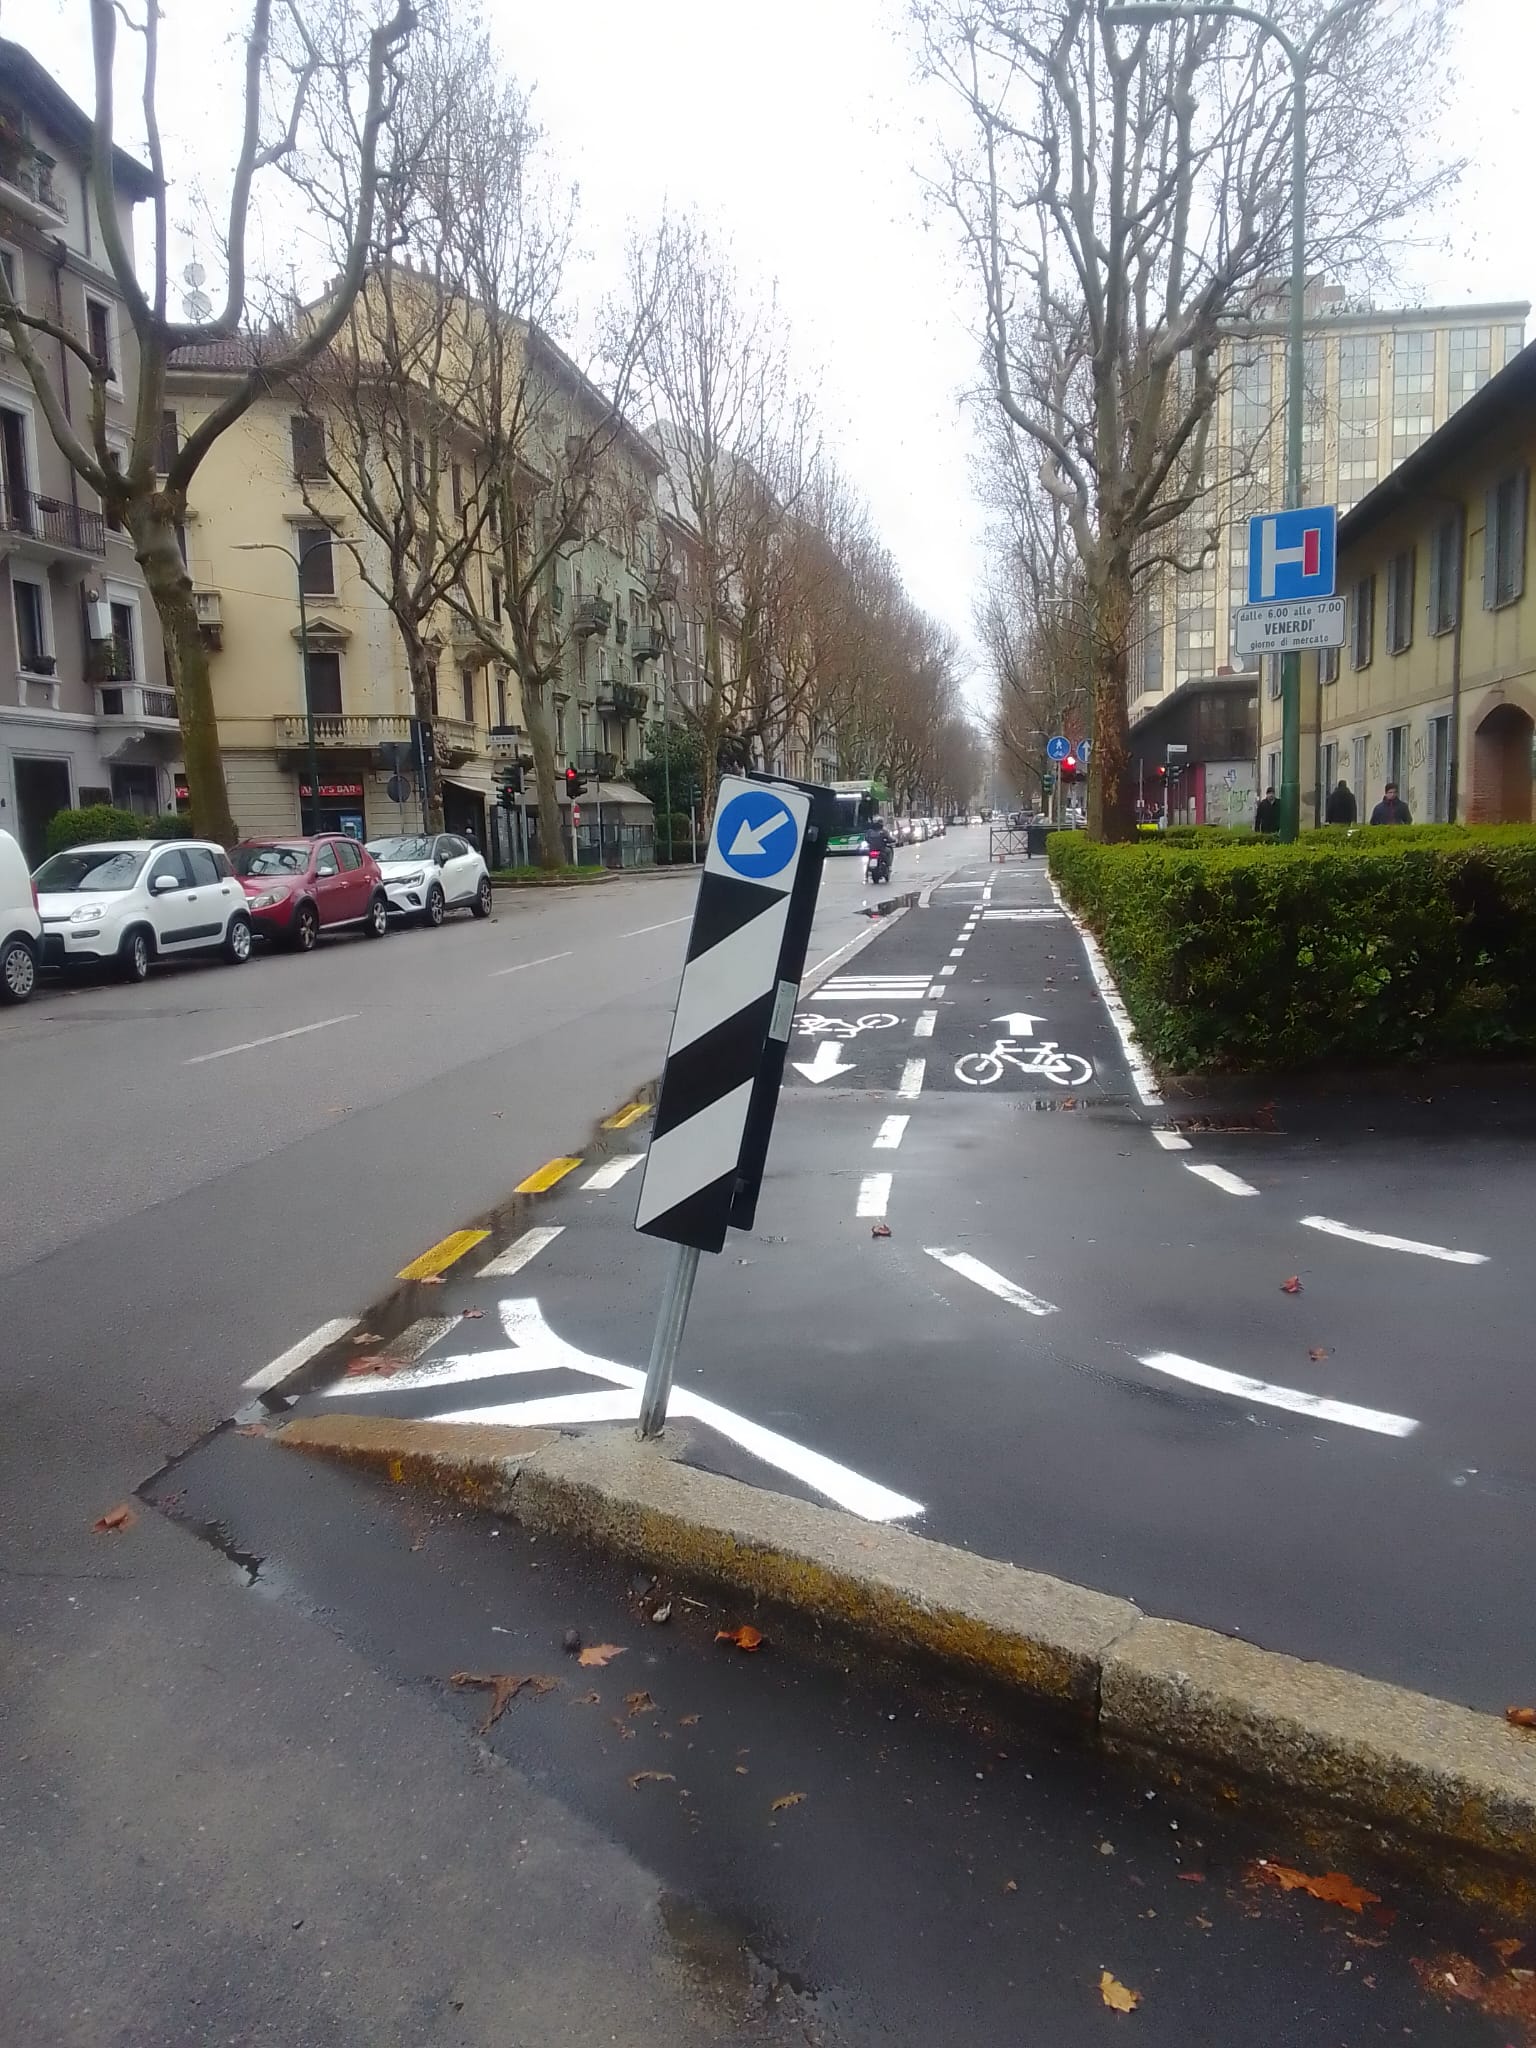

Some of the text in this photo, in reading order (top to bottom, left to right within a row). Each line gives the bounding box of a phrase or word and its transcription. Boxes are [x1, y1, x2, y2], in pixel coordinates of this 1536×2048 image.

[1240, 602, 1341, 622] dalle 6.00 alle 17.00
[1250, 634, 1328, 650] giorno di mercato
[336, 785, 356, 793] BAR
